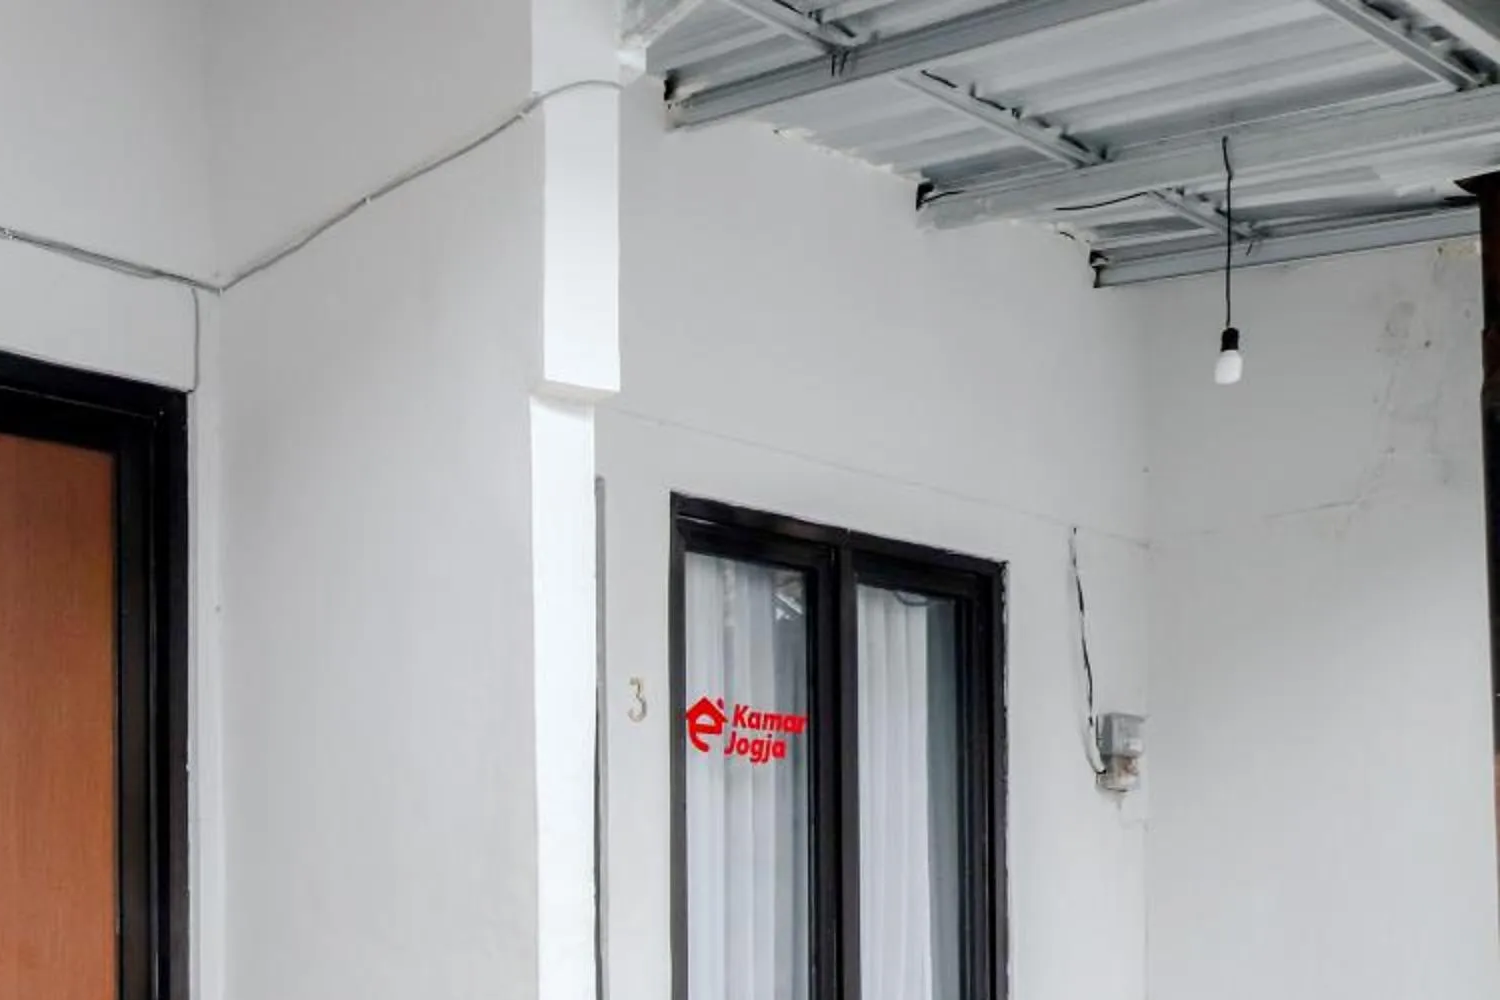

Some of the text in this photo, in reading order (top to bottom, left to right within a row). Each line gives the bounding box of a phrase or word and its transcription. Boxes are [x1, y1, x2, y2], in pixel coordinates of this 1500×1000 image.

[627, 676, 647, 722] 3
[731, 703, 810, 735] Kamar
[723, 730, 787, 765] Jogja
